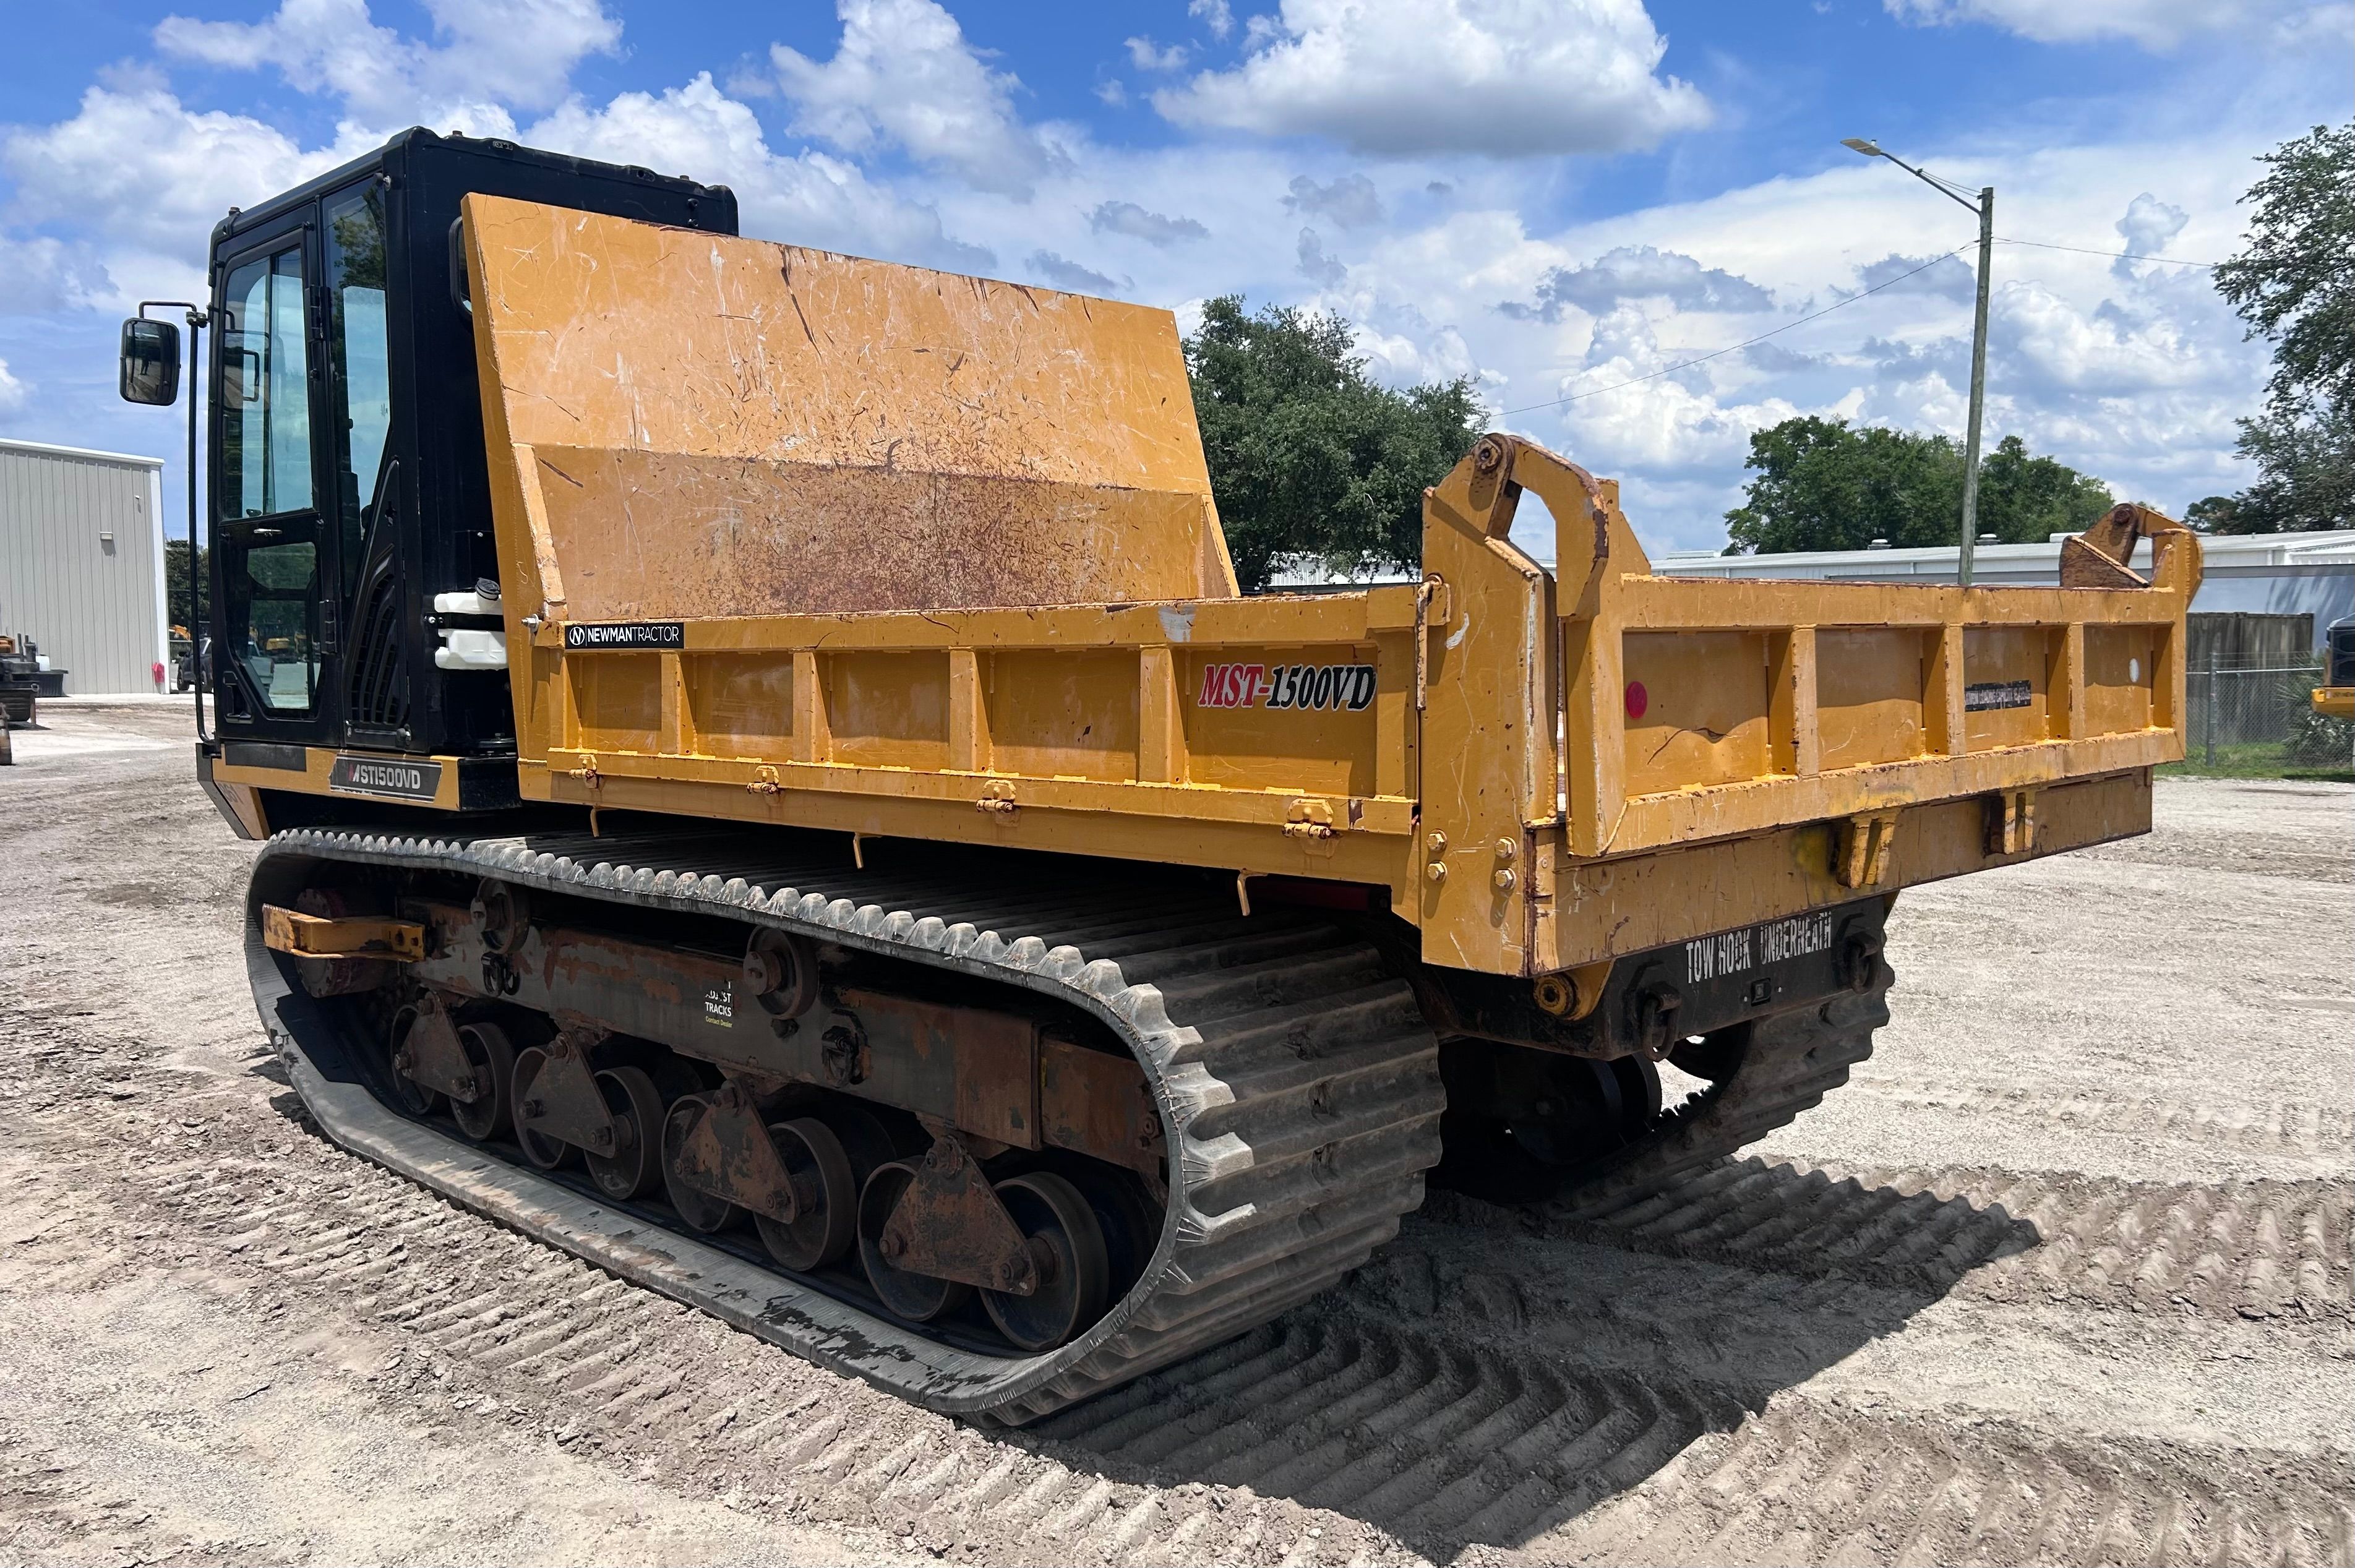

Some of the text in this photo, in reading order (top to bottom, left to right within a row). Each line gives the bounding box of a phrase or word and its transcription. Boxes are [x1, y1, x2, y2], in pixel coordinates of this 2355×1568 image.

[1199, 665, 1377, 710] MST-1500VD
[348, 764, 421, 789] MST1500VD
[1686, 911, 1831, 983] TOW HOOK UNDERNEATH
[705, 1001, 732, 1016] TRACKS
[705, 1016, 732, 1028] Contact Dealer
